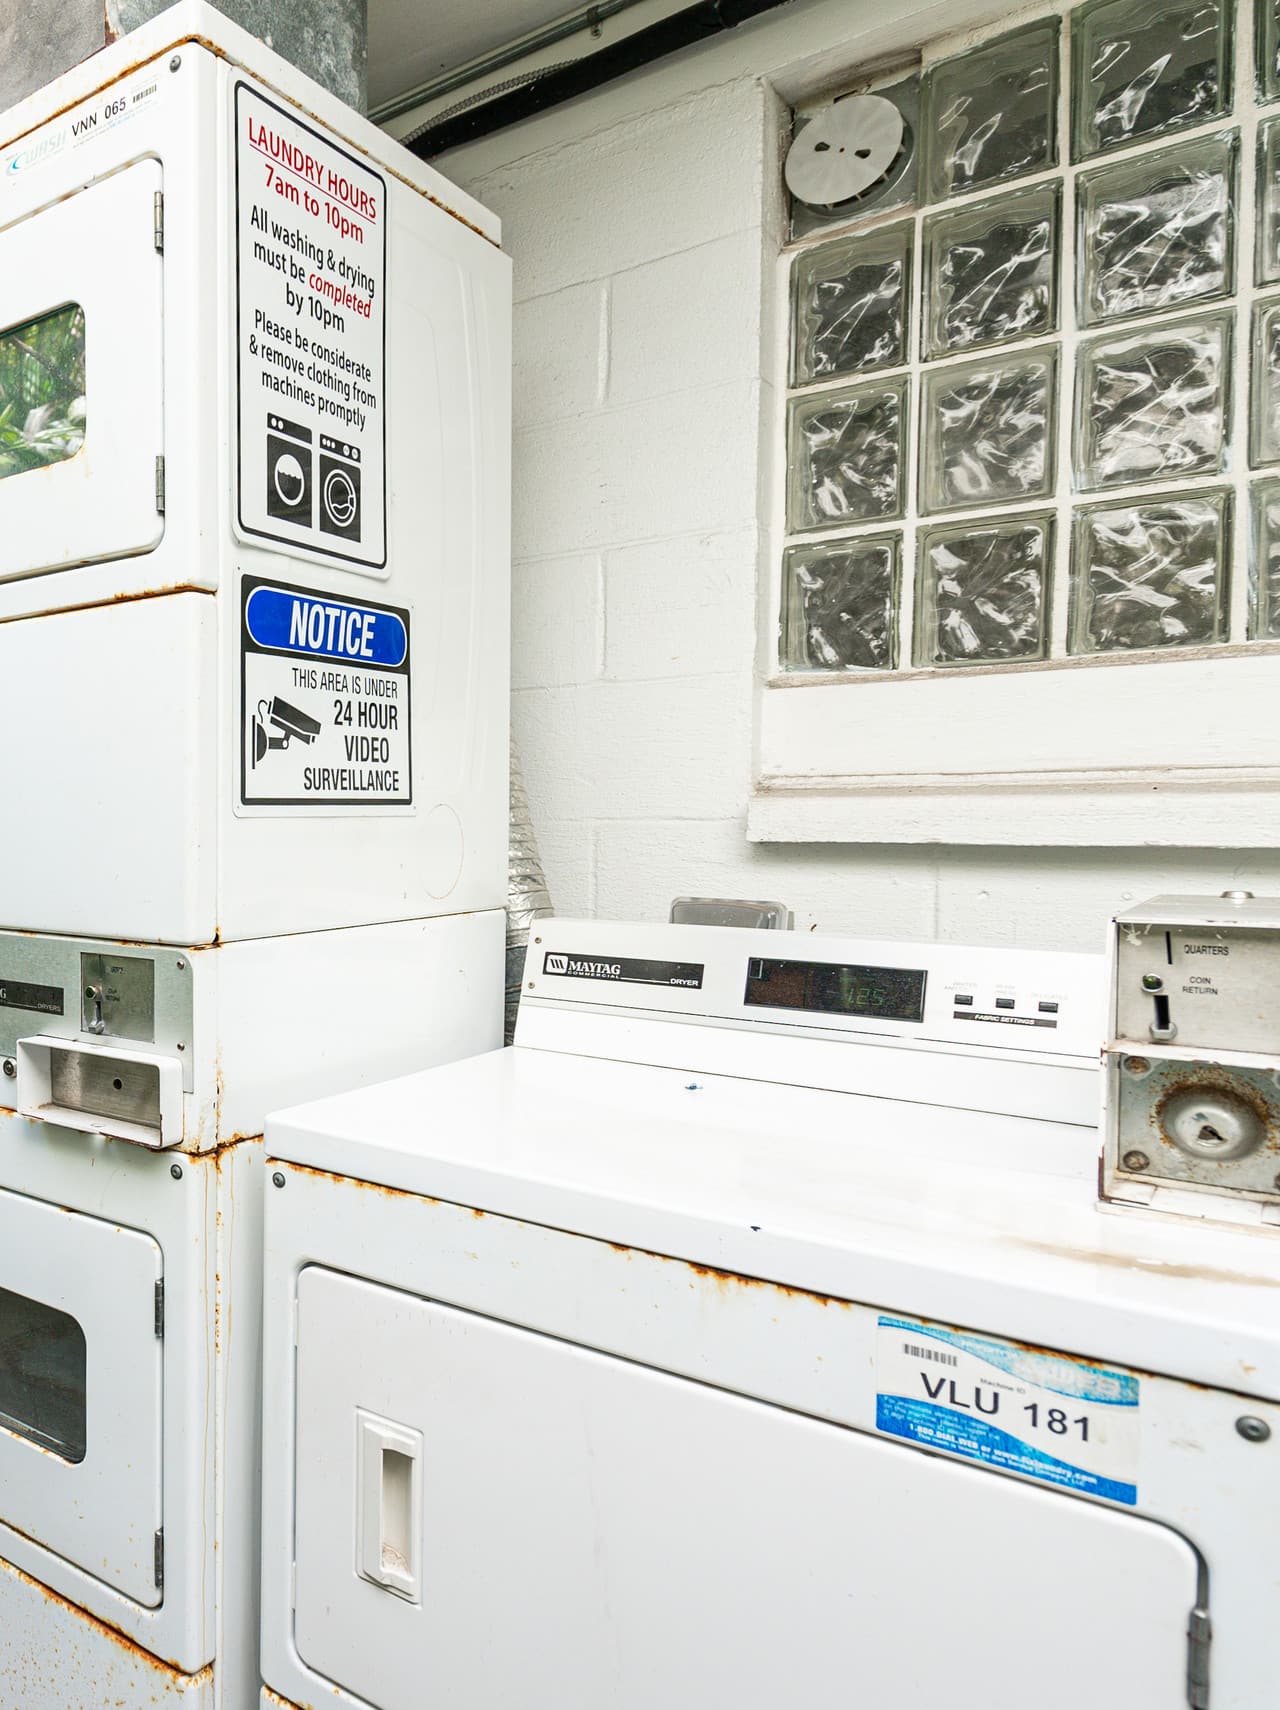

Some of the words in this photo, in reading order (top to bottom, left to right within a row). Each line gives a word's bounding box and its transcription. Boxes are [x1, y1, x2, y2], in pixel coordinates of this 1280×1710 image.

[72, 112, 97, 136] VNN
[104, 97, 127, 120] 065
[248, 117, 324, 186] LAUNDRY
[327, 169, 377, 219] HOURS
[265, 163, 299, 205] 7am
[304, 190, 320, 217] to
[324, 202, 364, 244] 10pm
[250, 204, 268, 234] All
[271, 218, 324, 270] washing
[326, 249, 336, 272] &
[338, 256, 375, 298] drying
[253, 240, 287, 275] must
[289, 254, 305, 284] be
[309, 273, 372, 319] completed
[286, 282, 304, 316] by
[308, 296, 345, 333] 10pm
[254, 308, 292, 345] Please
[295, 327, 309, 352] be
[311, 341, 372, 382] considerate
[249, 334, 258, 355] &
[261, 343, 304, 377] remove
[307, 362, 350, 402] clothing
[353, 382, 377, 408] from
[261, 370, 315, 407] machines
[318, 394, 366, 432] promptly
[289, 599, 376, 657] NOTICE
[292, 667, 317, 690] THIS
[320, 671, 349, 693] AREA
[351, 675, 361, 694] IS
[364, 677, 398, 699] UNDER
[333, 699, 353, 727] 24
[358, 701, 398, 730] HOUR
[344, 735, 390, 763] VIDEO
[303, 767, 400, 792] SURVEILLANCE
[569, 960, 621, 975] MAYTAG
[1184, 944, 1230, 957] QUARTERS
[670, 978, 699, 987] DRYER
[1182, 985, 1219, 996] RETURN
[1189, 976, 1212, 985] COIN
[975, 1014, 1000, 1022] FABRIC
[1000, 1016, 1035, 1025] SETTINGS
[920, 1372, 1000, 1415] VLU
[1023, 1403, 1089, 1442] 181
